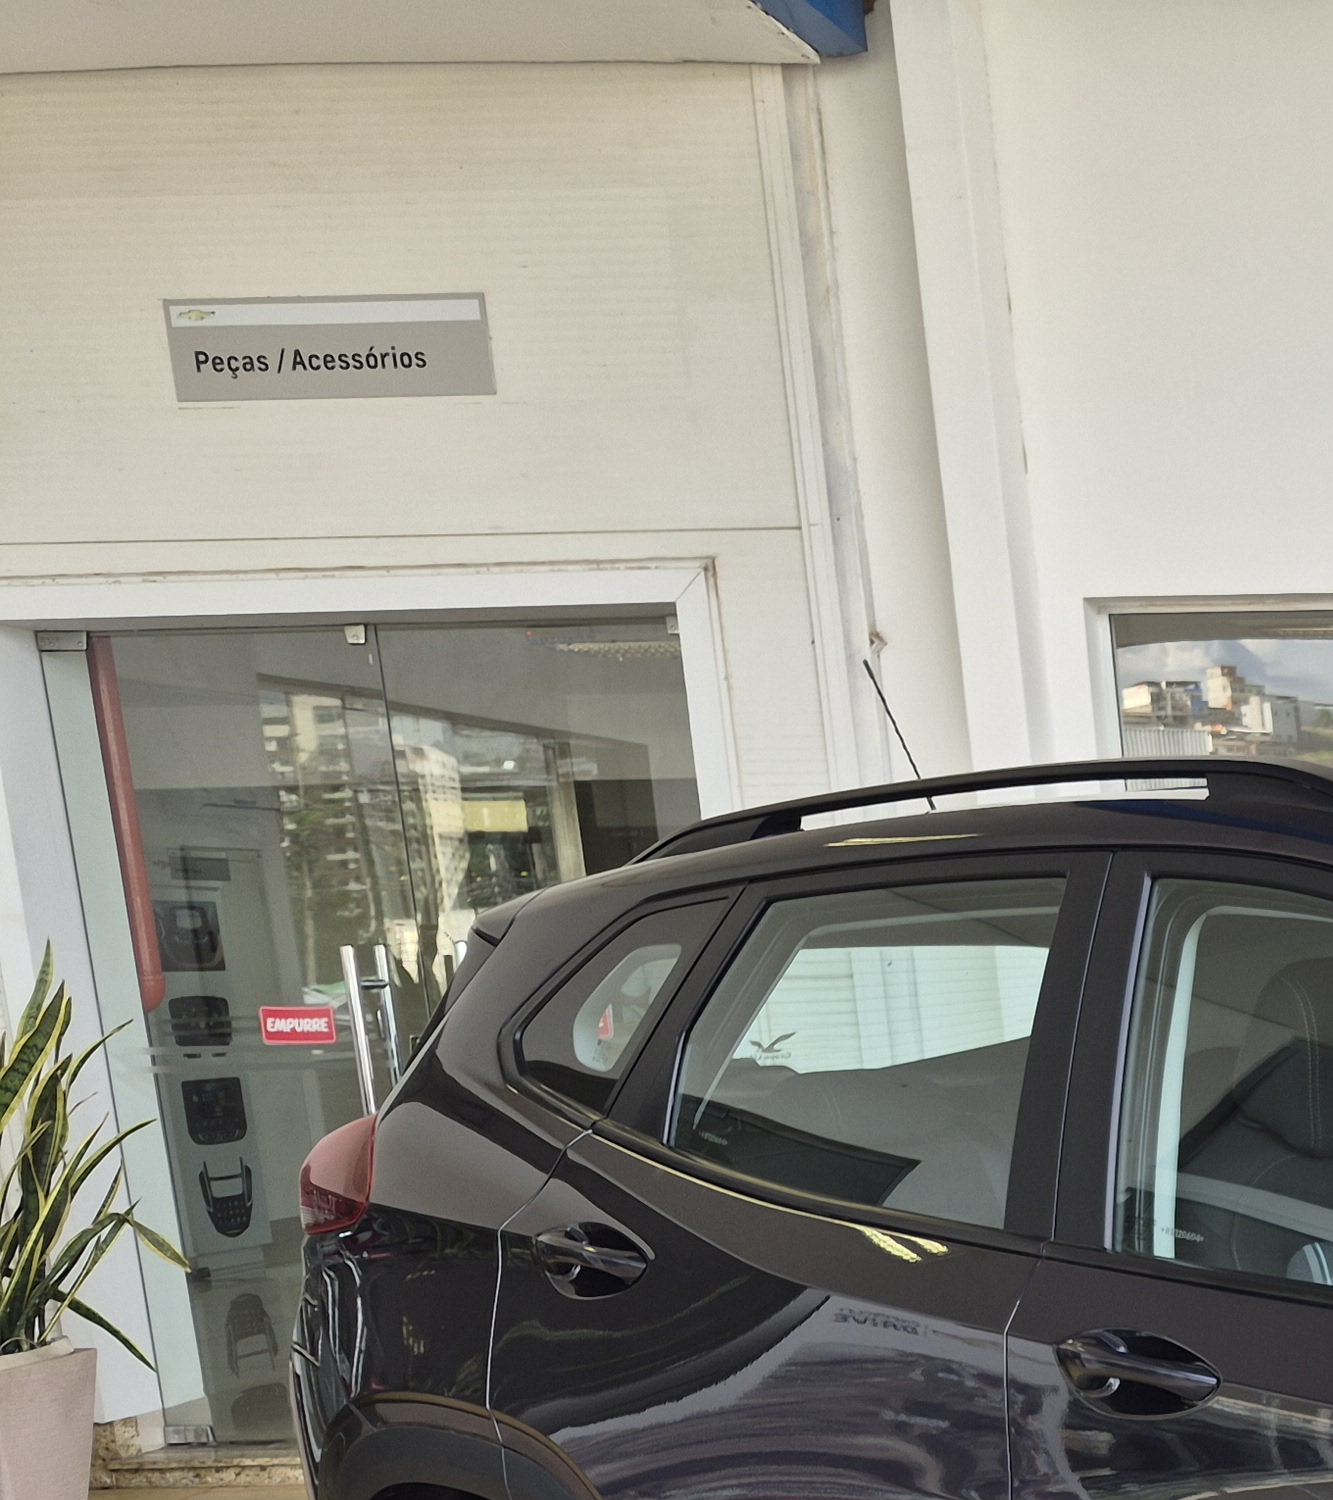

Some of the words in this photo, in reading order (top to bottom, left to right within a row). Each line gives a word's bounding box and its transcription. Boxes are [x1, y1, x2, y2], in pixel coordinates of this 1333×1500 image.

[193, 350, 270, 380] Peças
[291, 345, 428, 372] Acessórios
[266, 1016, 330, 1033] EMPURRE
